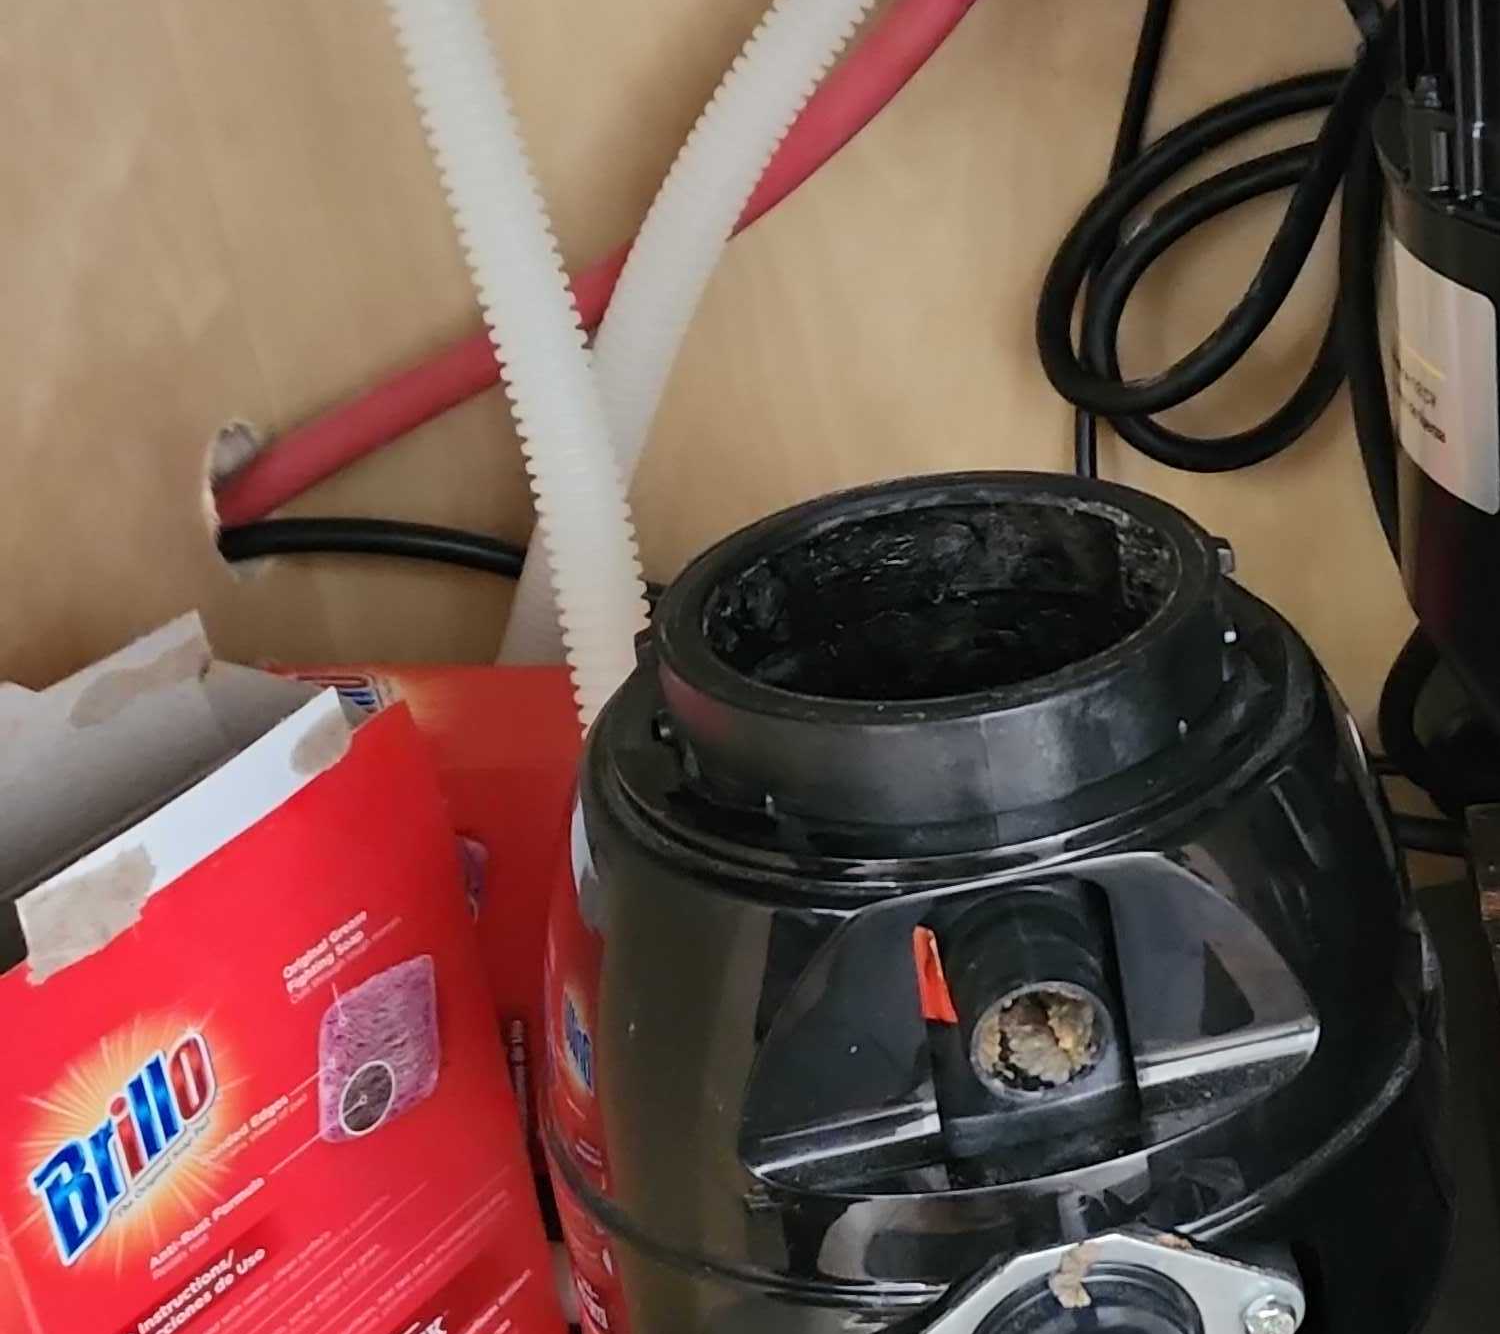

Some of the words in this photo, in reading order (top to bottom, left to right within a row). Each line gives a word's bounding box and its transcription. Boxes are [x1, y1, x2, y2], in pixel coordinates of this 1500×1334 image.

[27, 1028, 217, 1267] Brillo
[137, 1249, 233, 1334] Instructions/
[213, 1273, 233, 1293] de
[235, 1248, 265, 1274] Uso
